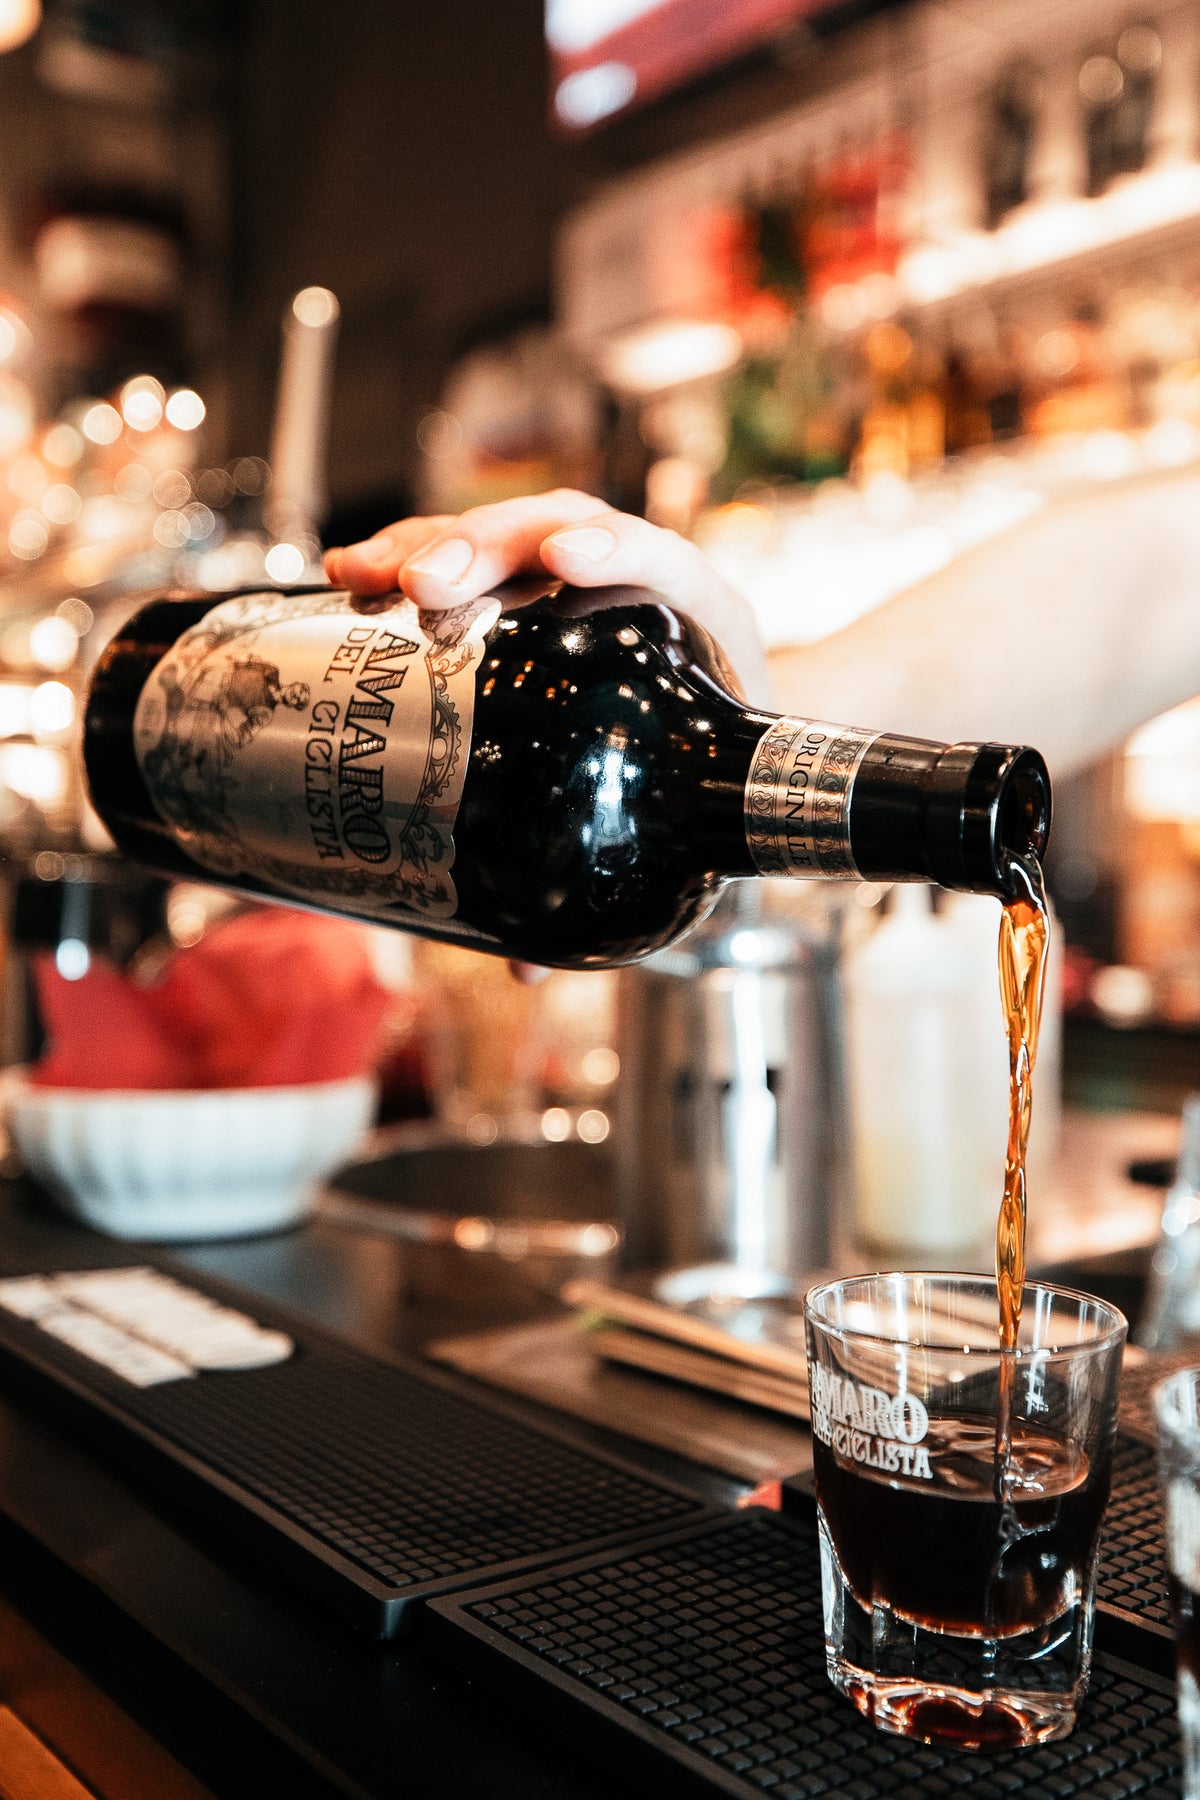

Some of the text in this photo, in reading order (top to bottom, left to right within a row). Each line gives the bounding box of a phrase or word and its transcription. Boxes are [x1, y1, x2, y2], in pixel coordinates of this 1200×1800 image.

[305, 627, 378, 861] DEL CICLISTA
[338, 628, 422, 864] AMARO
[785, 733, 827, 867] ORIGINALE
[834, 1425, 934, 1480] CICLISTA
